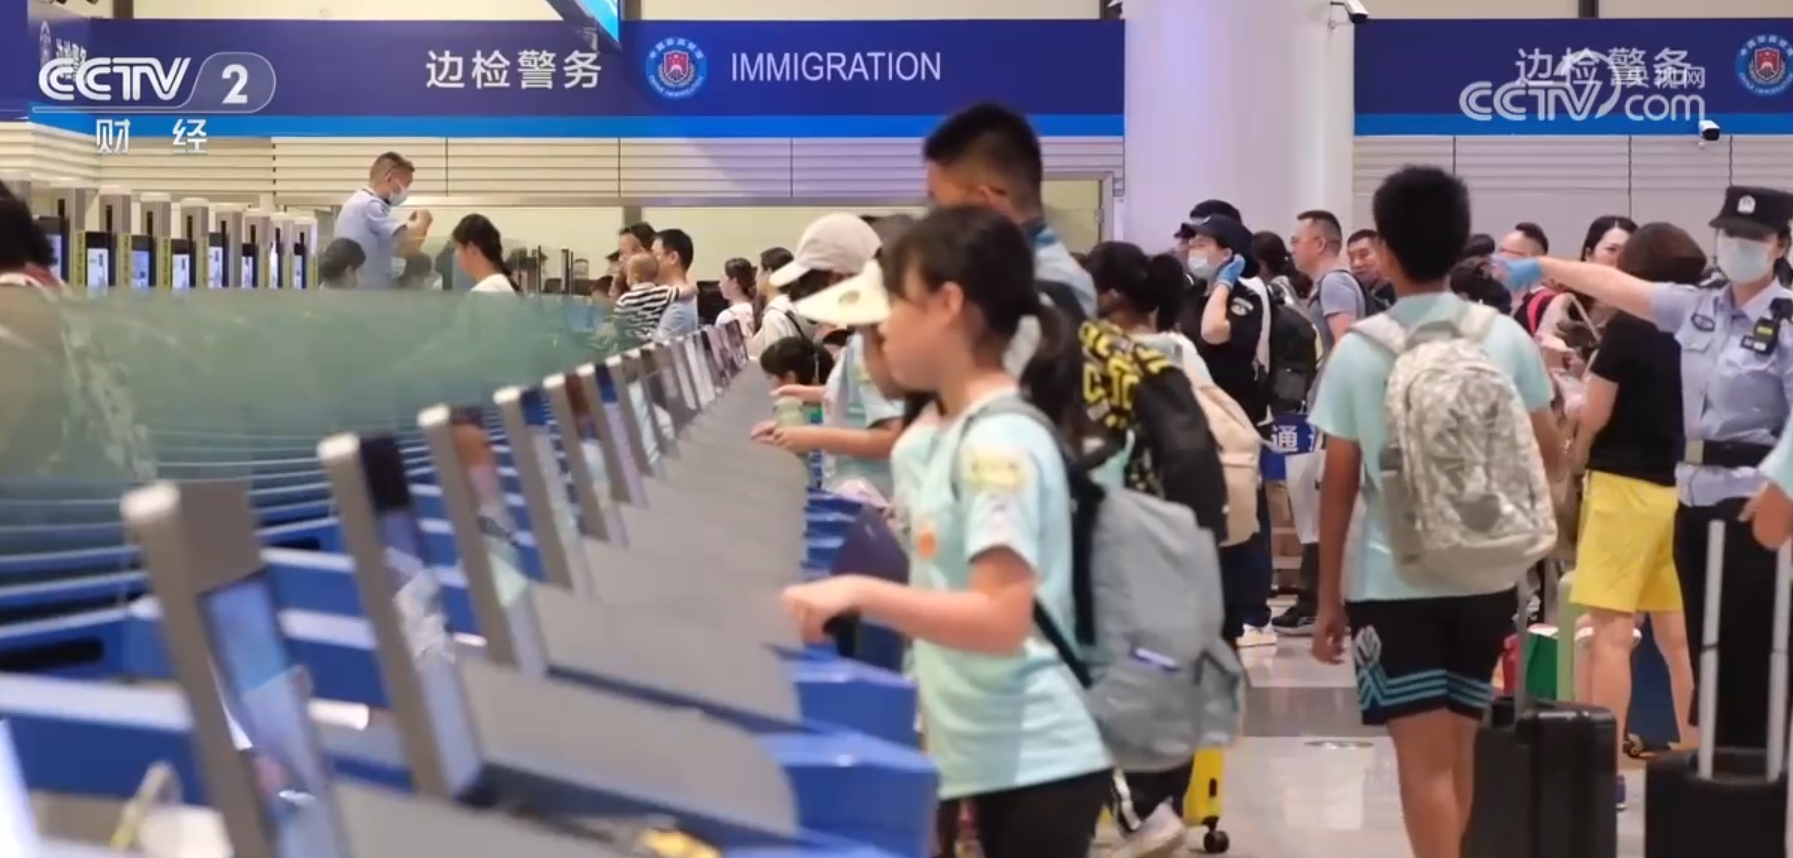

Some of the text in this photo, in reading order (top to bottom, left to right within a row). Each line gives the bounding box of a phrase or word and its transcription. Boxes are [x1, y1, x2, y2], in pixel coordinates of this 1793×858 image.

[426, 49, 601, 89] 边检警务
[731, 51, 941, 82] IMMIGRATION
[1515, 47, 1692, 87] 边检警务
[1271, 424, 1315, 453] 通
